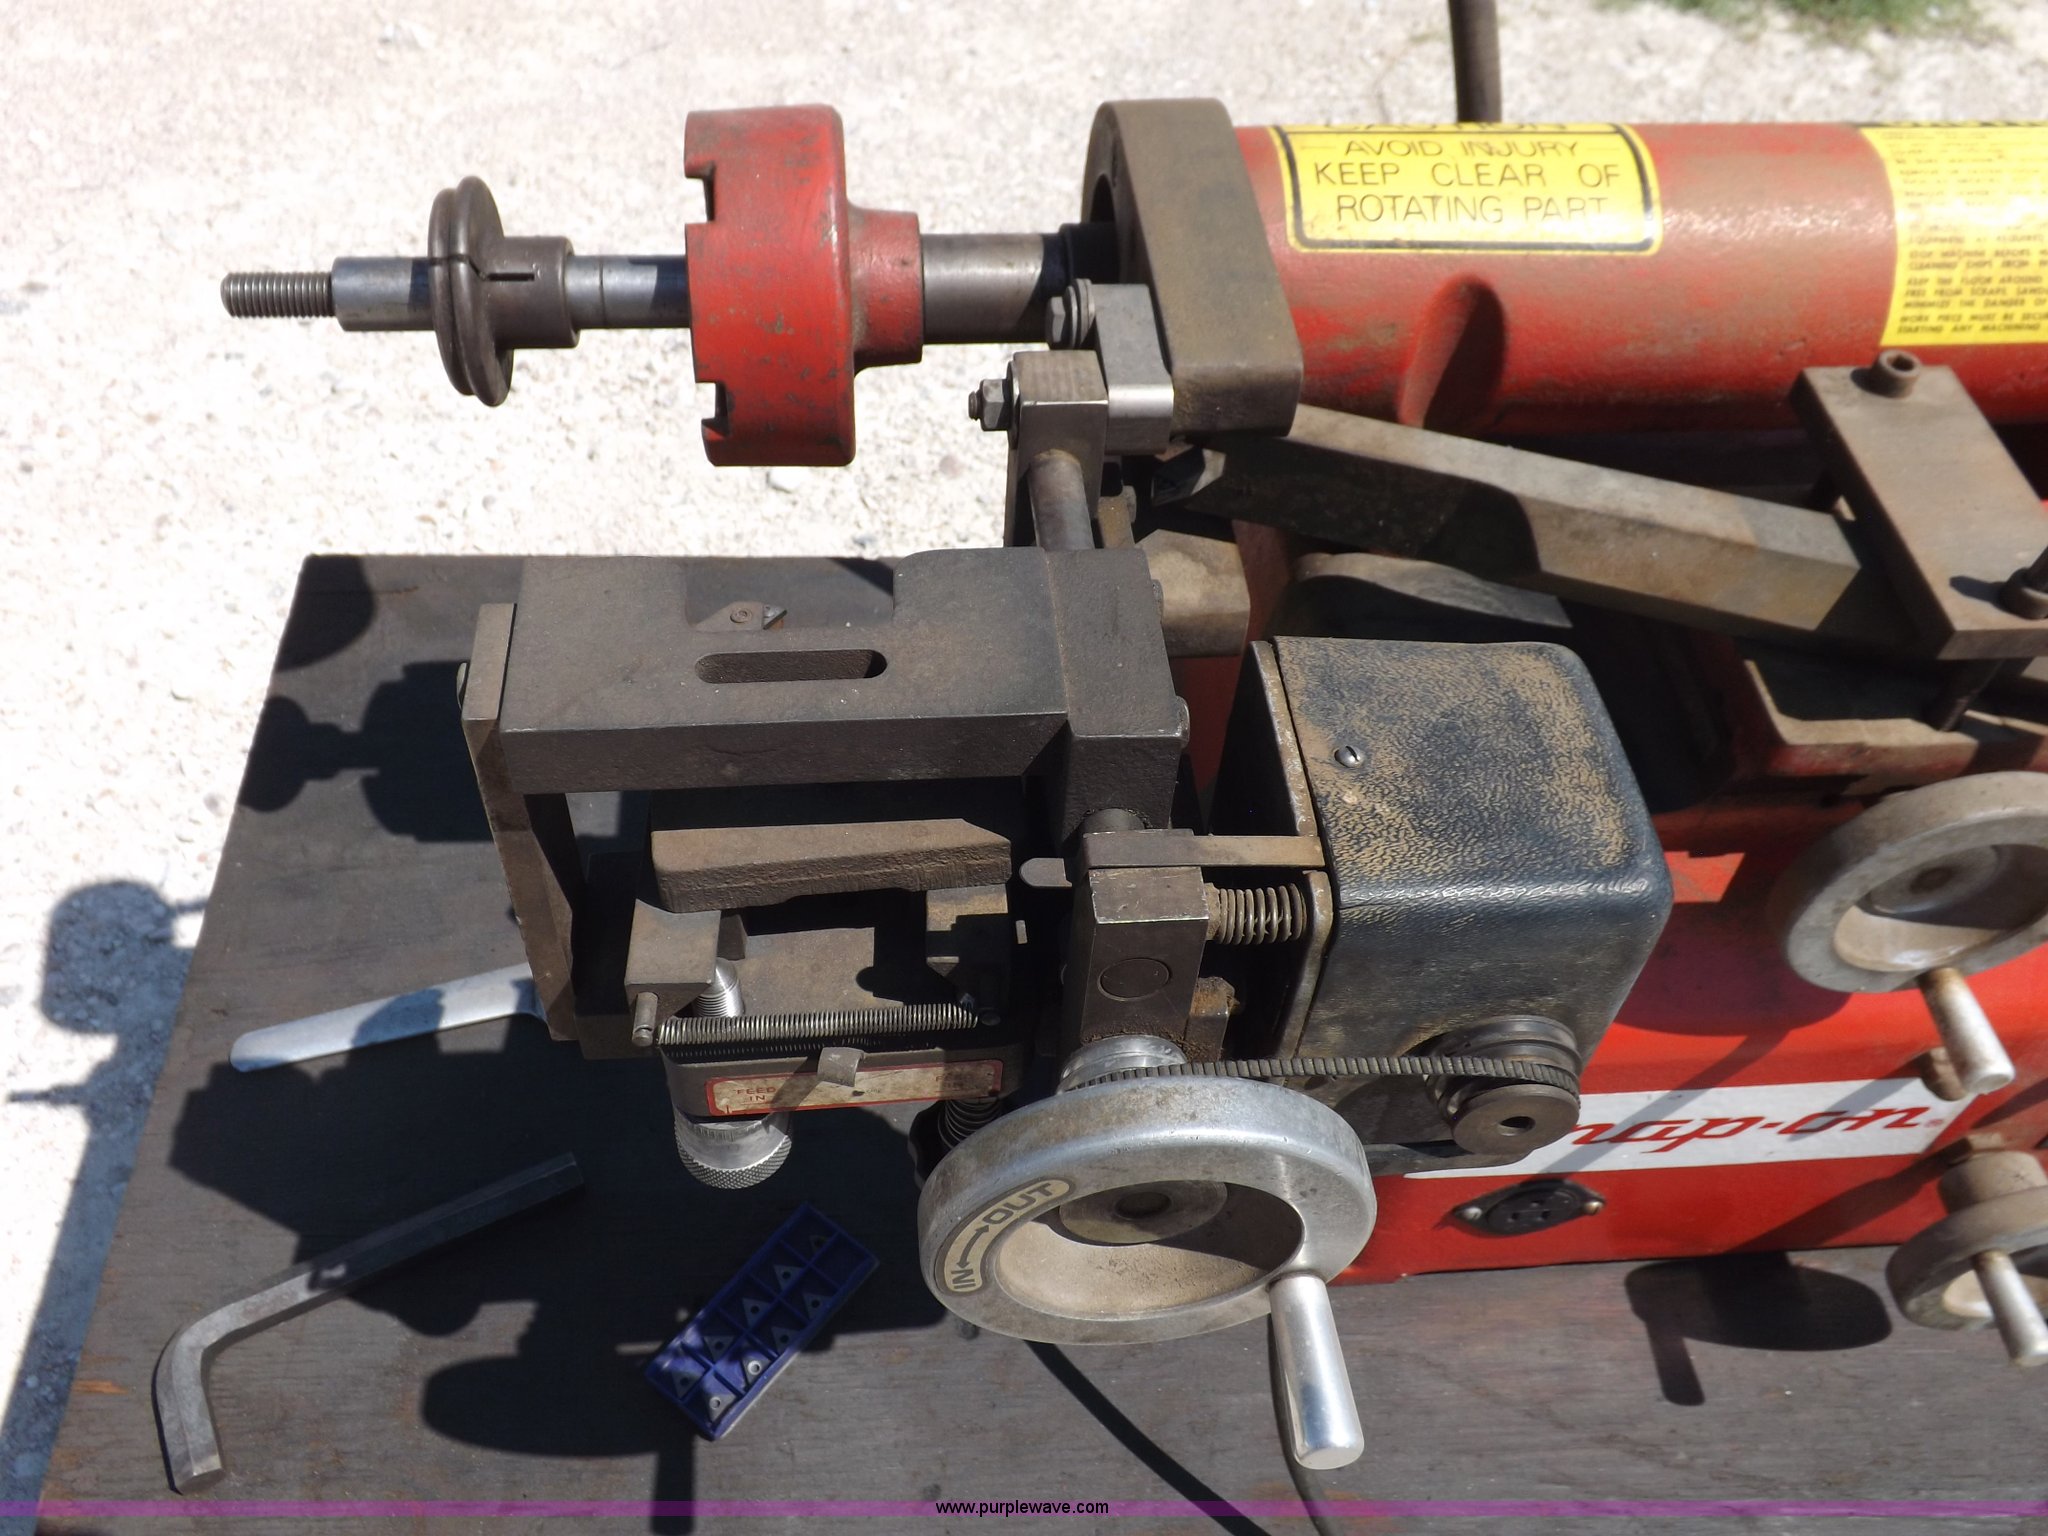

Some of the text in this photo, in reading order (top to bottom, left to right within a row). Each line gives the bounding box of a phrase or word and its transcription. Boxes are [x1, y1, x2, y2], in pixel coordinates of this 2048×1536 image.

[1345, 139, 1578, 158] AVOID INJURY
[1314, 161, 1621, 188] KEEP CLEAR OF
[1336, 193, 1609, 223] ROTATING PART
[736, 1086, 777, 1095] FEED
[1571, 1106, 1931, 1154] nap-on
[950, 1182, 1054, 1290] IN OUT
